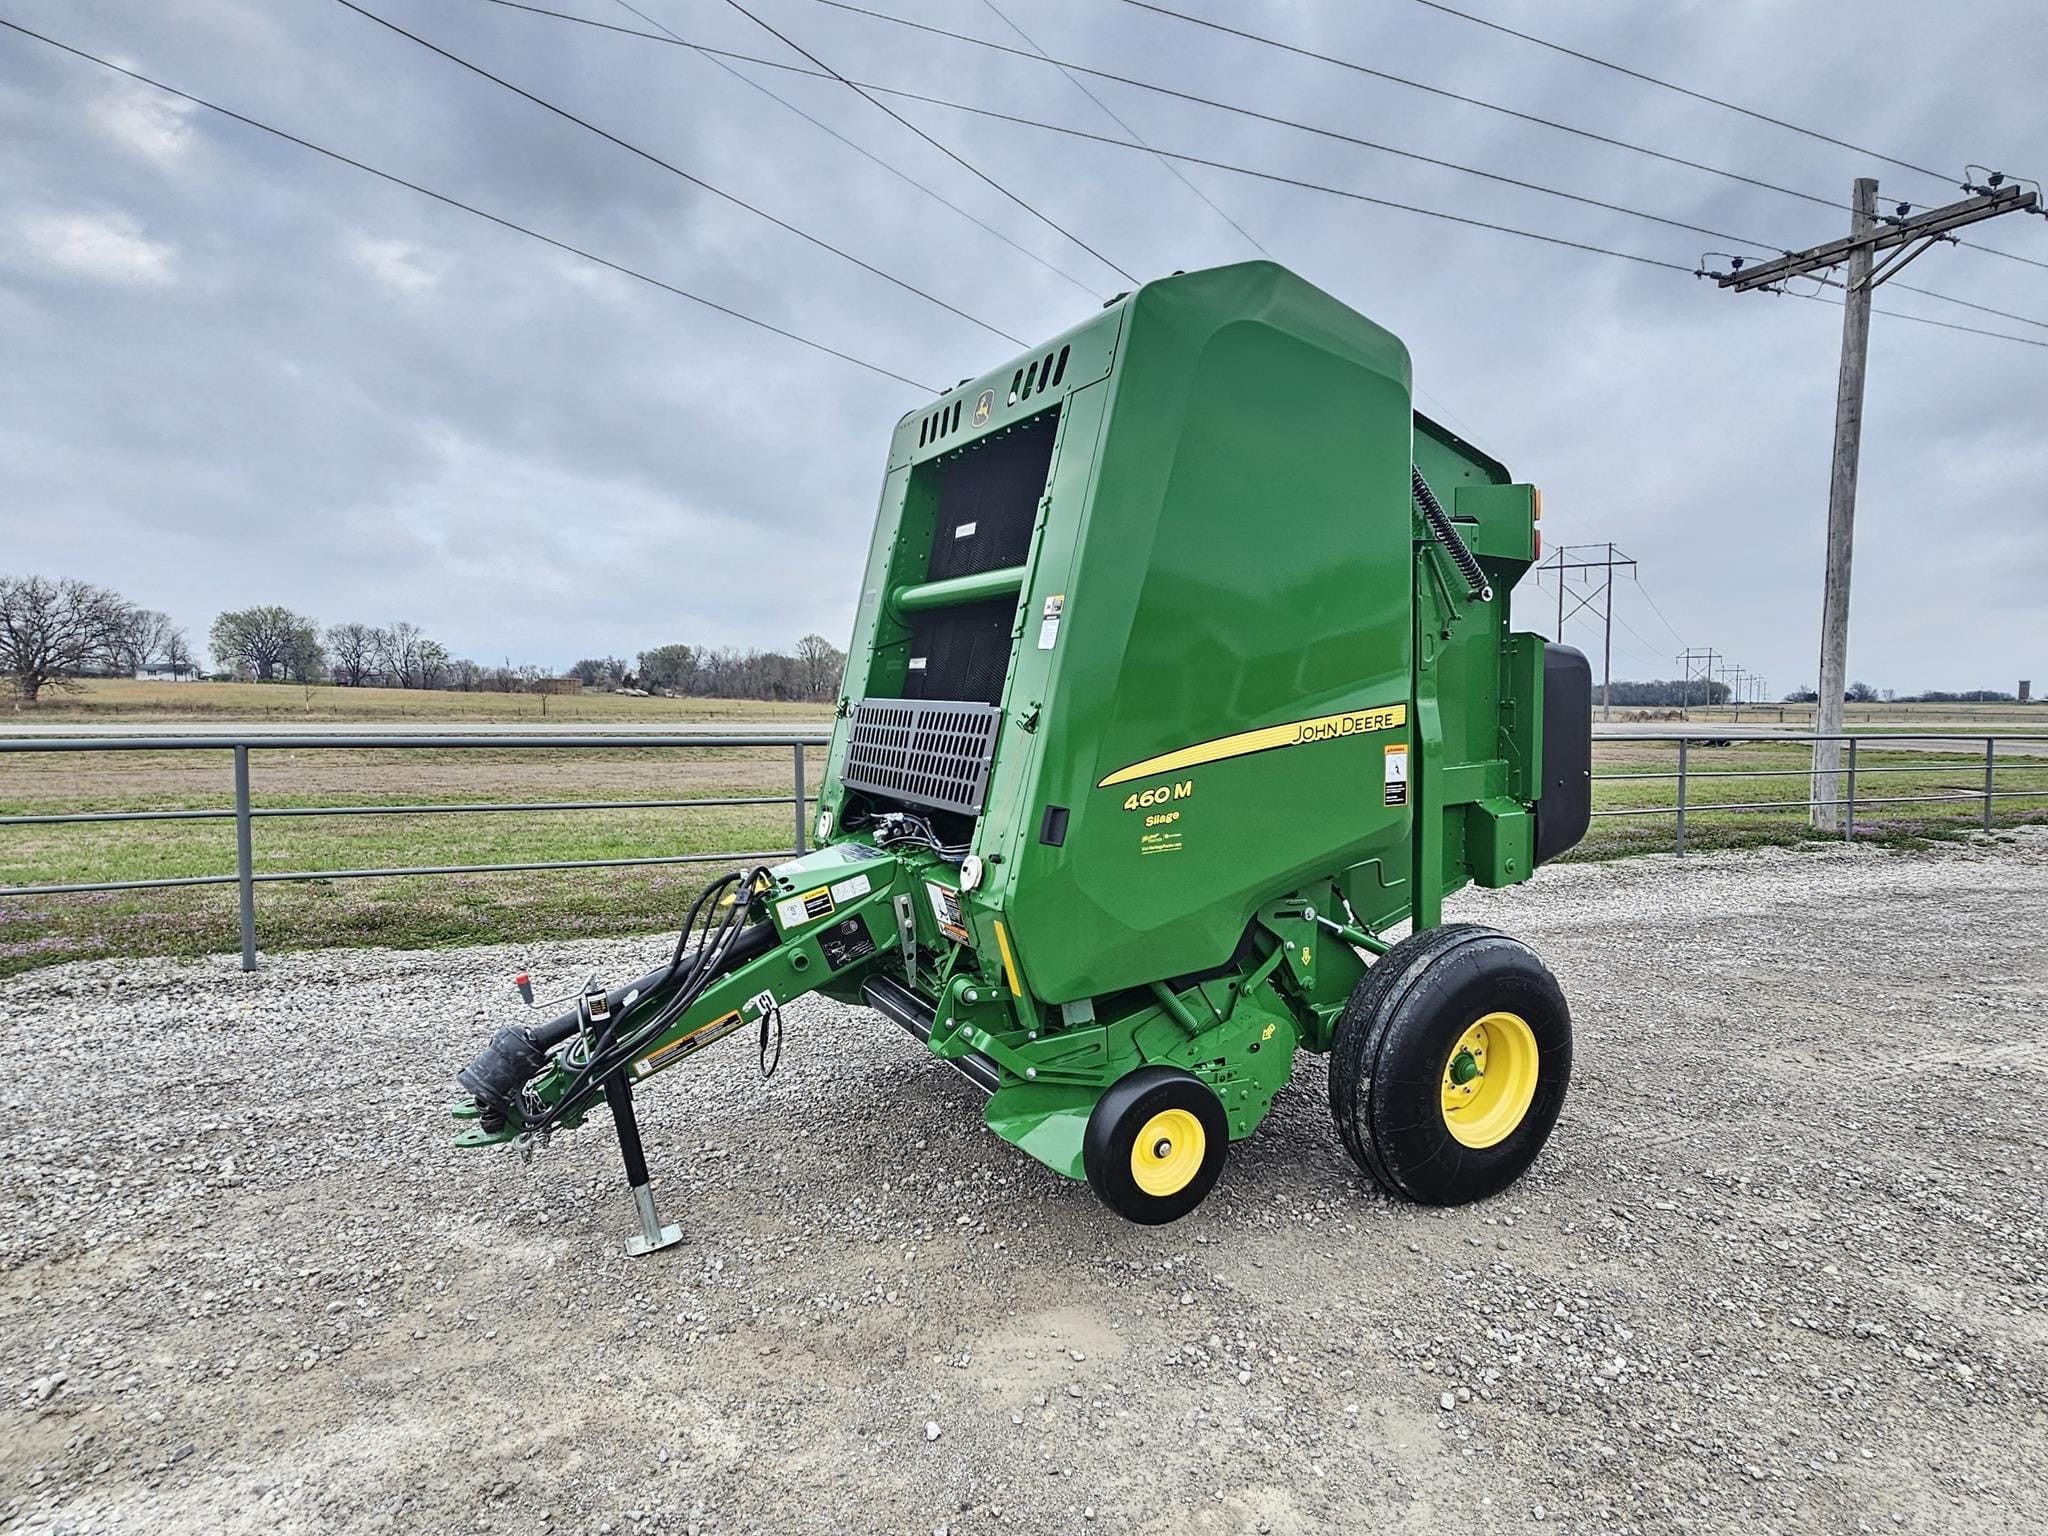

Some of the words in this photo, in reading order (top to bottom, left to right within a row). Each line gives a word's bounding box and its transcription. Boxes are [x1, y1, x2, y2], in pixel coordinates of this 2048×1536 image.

[1292, 722, 1338, 742] JOHN
[1342, 713, 1394, 733] DEERE
[1123, 786, 1171, 811] 460
[1173, 779, 1193, 800] M
[1145, 811, 1180, 828] Silage
